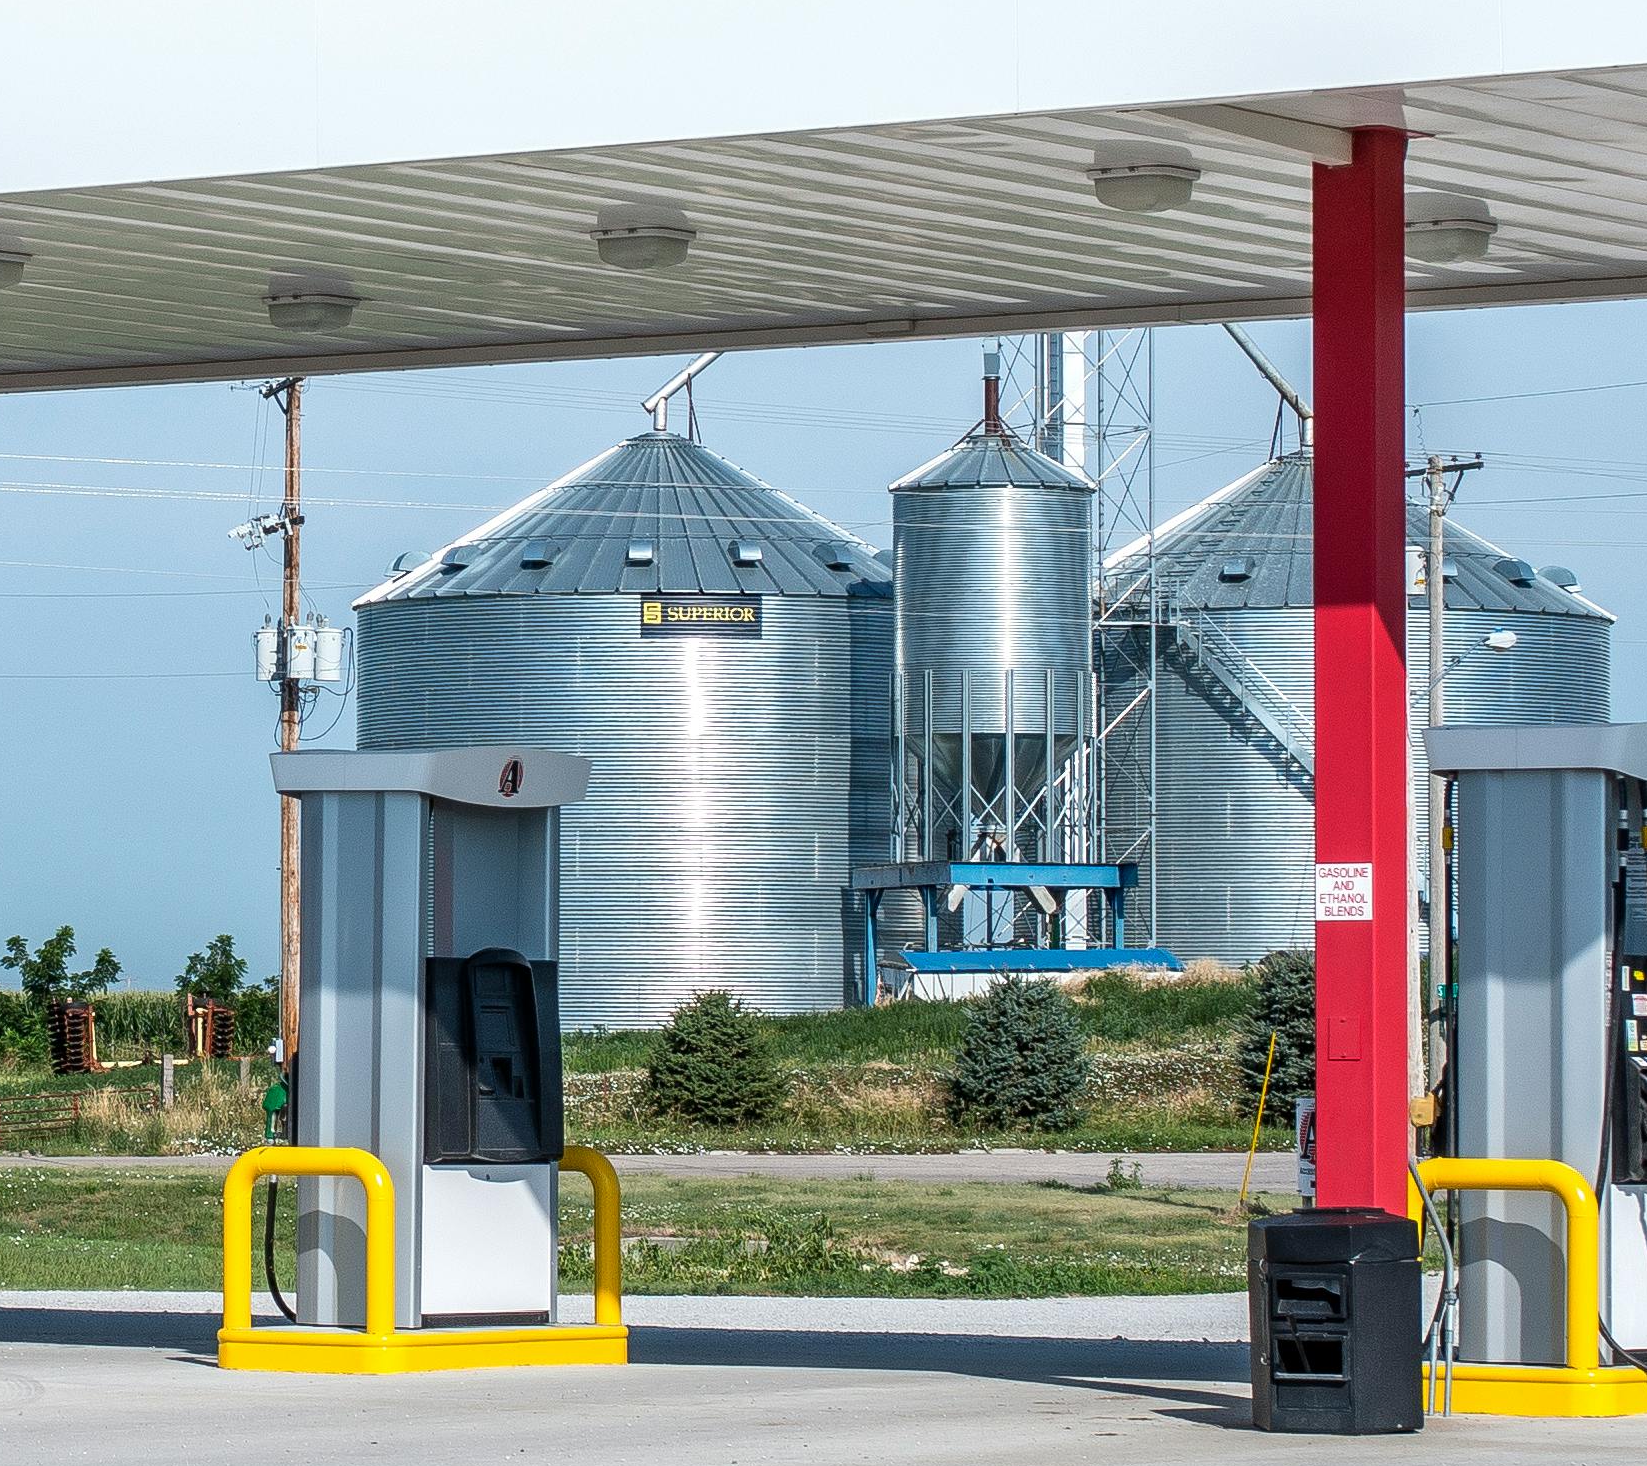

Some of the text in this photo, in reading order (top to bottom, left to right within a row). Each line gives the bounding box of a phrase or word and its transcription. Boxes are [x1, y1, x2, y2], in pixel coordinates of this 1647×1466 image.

[667, 607, 755, 622] SUPERIOR
[1318, 867, 1369, 878] GASOLINE
[1333, 880, 1354, 891] AND
[1319, 893, 1368, 904] ETHANOL
[1324, 906, 1364, 916] BLENDS
